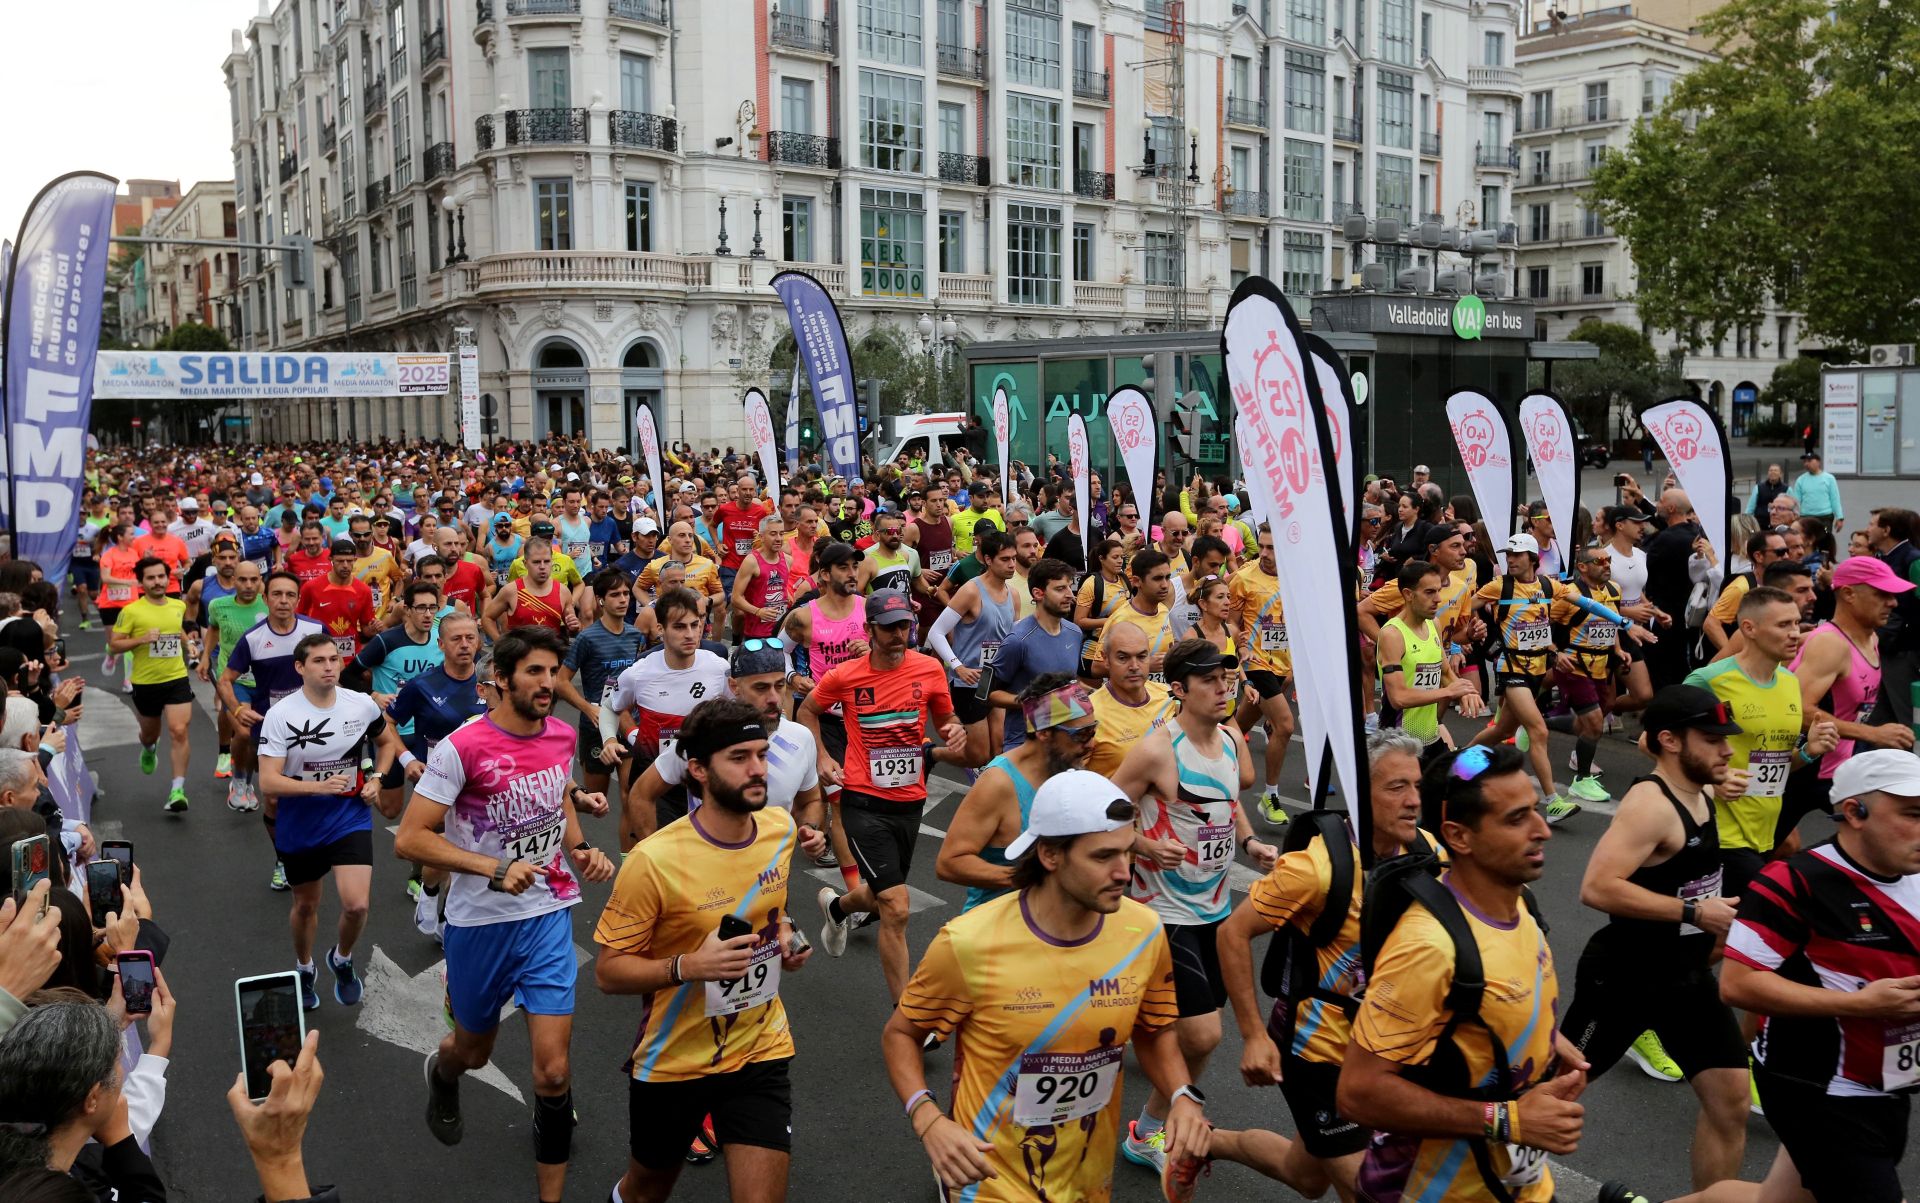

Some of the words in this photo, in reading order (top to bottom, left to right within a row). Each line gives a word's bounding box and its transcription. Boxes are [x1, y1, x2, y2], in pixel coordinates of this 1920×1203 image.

[861, 242, 905, 263] KER
[67, 223, 91, 333] Deportes
[863, 271, 921, 291] 2000
[30, 249, 53, 360] Fundación
[47, 253, 70, 363] Municipal
[1387, 303, 1449, 327] Valladolid
[1457, 307, 1481, 330] VA!
[1485, 314, 1500, 329] en
[1502, 311, 1522, 330] bus
[64, 339, 78, 366] de
[178, 355, 330, 385] SALIDA
[399, 365, 448, 383] 2025
[102, 379, 129, 388] MEDIA
[131, 378, 175, 389] MARATÓN
[180, 387, 209, 396] MEDIA
[255, 387, 261, 395] Y
[263, 387, 290, 395] LEGUA
[291, 386, 329, 395] POPULAR
[334, 379, 358, 387] MEDIA
[358, 378, 394, 387] MARATÓN
[12, 367, 84, 534] FMD
[931, 554, 950, 565] 2719
[1520, 628, 1549, 643] 2493
[1590, 628, 1616, 639] 2633
[152, 640, 178, 651] 1734
[874, 758, 917, 777] 1931
[1757, 764, 1786, 784] 327
[508, 763, 567, 801] MEDIA
[524, 820, 543, 831] MEDIA
[511, 824, 562, 861] 1472
[719, 962, 768, 998] 919
[1089, 975, 1139, 997] MM25
[1026, 1002, 1055, 1010] POPULARES
[1090, 996, 1139, 1009] VALLADOLID
[1042, 1064, 1057, 1073] DE
[1057, 1056, 1111, 1073] VALLADOLID
[1050, 1055, 1082, 1064] MEDIA
[1035, 1070, 1099, 1105] 920
